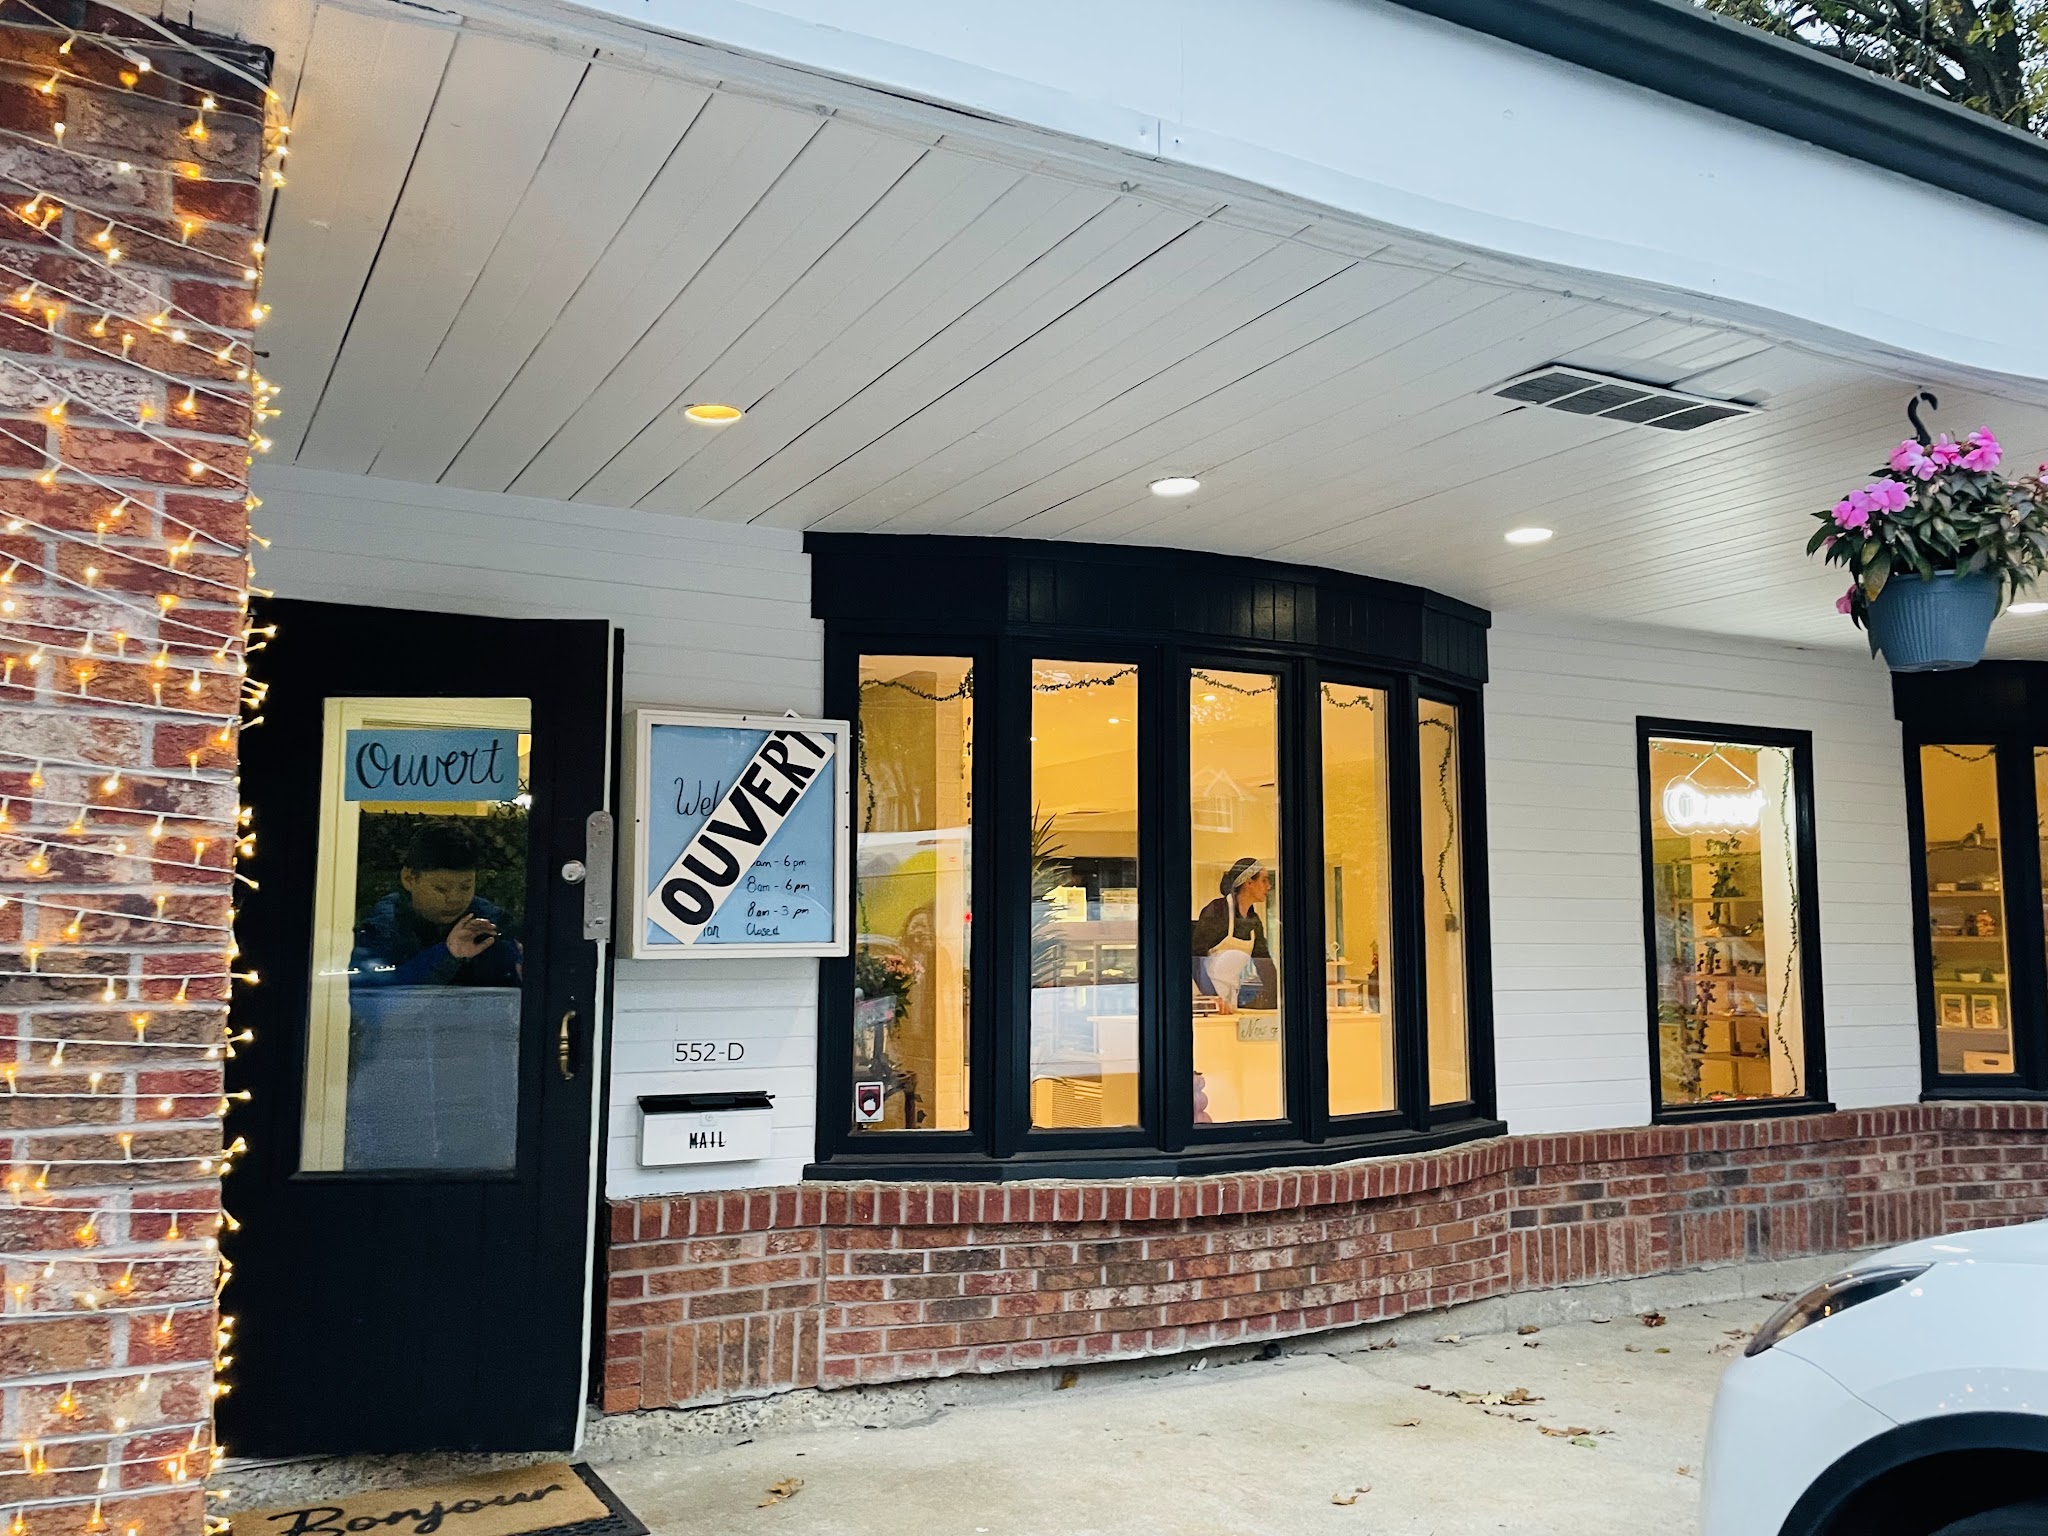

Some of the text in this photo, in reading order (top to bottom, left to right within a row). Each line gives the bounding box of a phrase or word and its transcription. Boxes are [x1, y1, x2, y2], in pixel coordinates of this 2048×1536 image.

[661, 713, 826, 926] OUVERT
[746, 922, 780, 937] Closed
[675, 1042, 744, 1062] 552-D
[689, 1131, 725, 1149] MAIL
[266, 1483, 564, 1536] Bonjour
